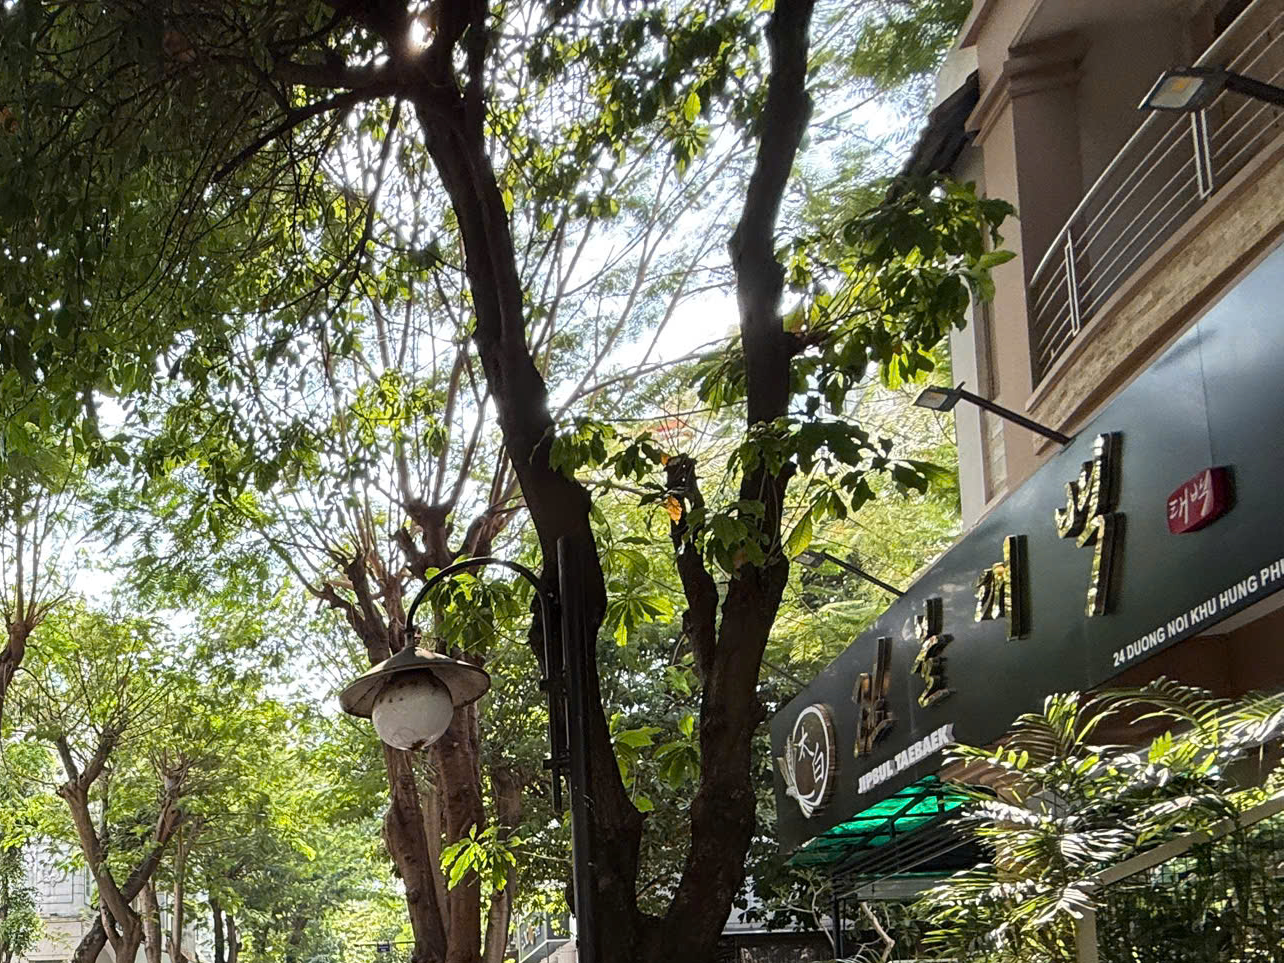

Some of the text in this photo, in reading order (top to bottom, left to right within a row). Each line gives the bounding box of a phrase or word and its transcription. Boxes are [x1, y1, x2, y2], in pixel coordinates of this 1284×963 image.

[1112, 648, 1126, 667] 24
[1125, 626, 1166, 660] DUONG
[1167, 613, 1189, 639] NOI
[1189, 597, 1217, 626] KHU
[1218, 575, 1259, 610] HUNG
[857, 723, 954, 794] JIPBUL TAEBAEK
